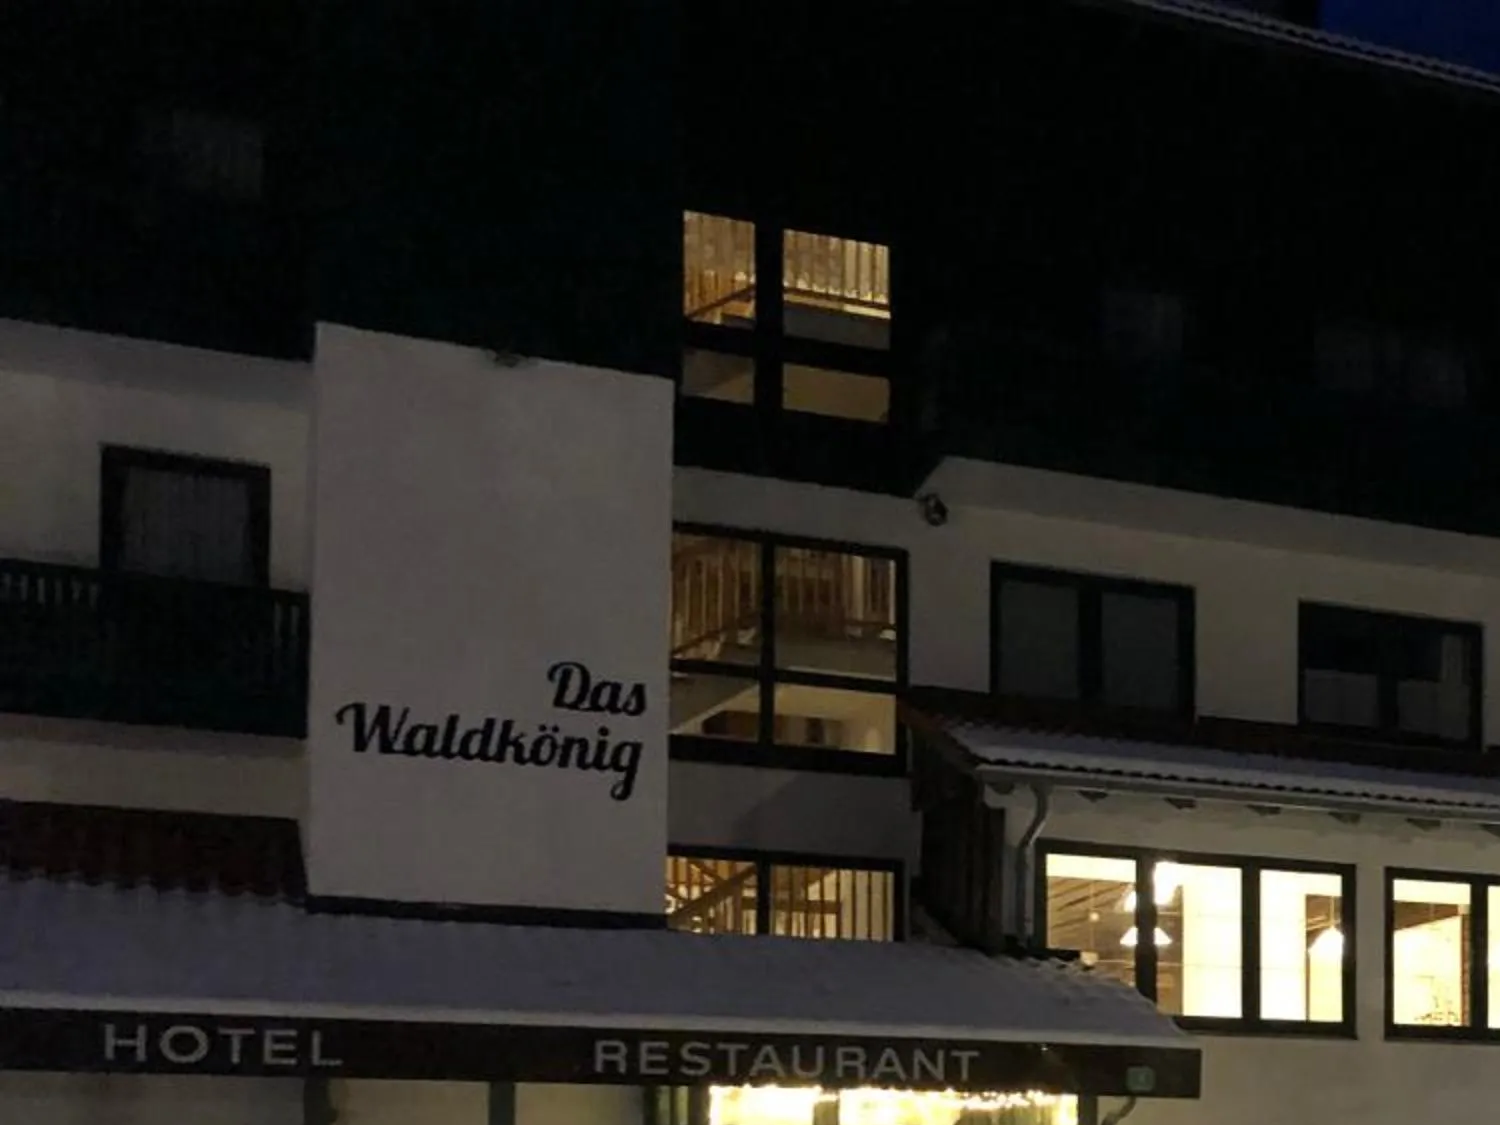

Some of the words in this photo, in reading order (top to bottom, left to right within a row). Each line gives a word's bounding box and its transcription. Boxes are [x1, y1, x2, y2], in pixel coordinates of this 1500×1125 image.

[547, 661, 647, 716] Das
[335, 702, 643, 801] Waldkönig
[103, 1023, 343, 1067] HOTEL
[593, 1039, 980, 1082] RESTAURANT
